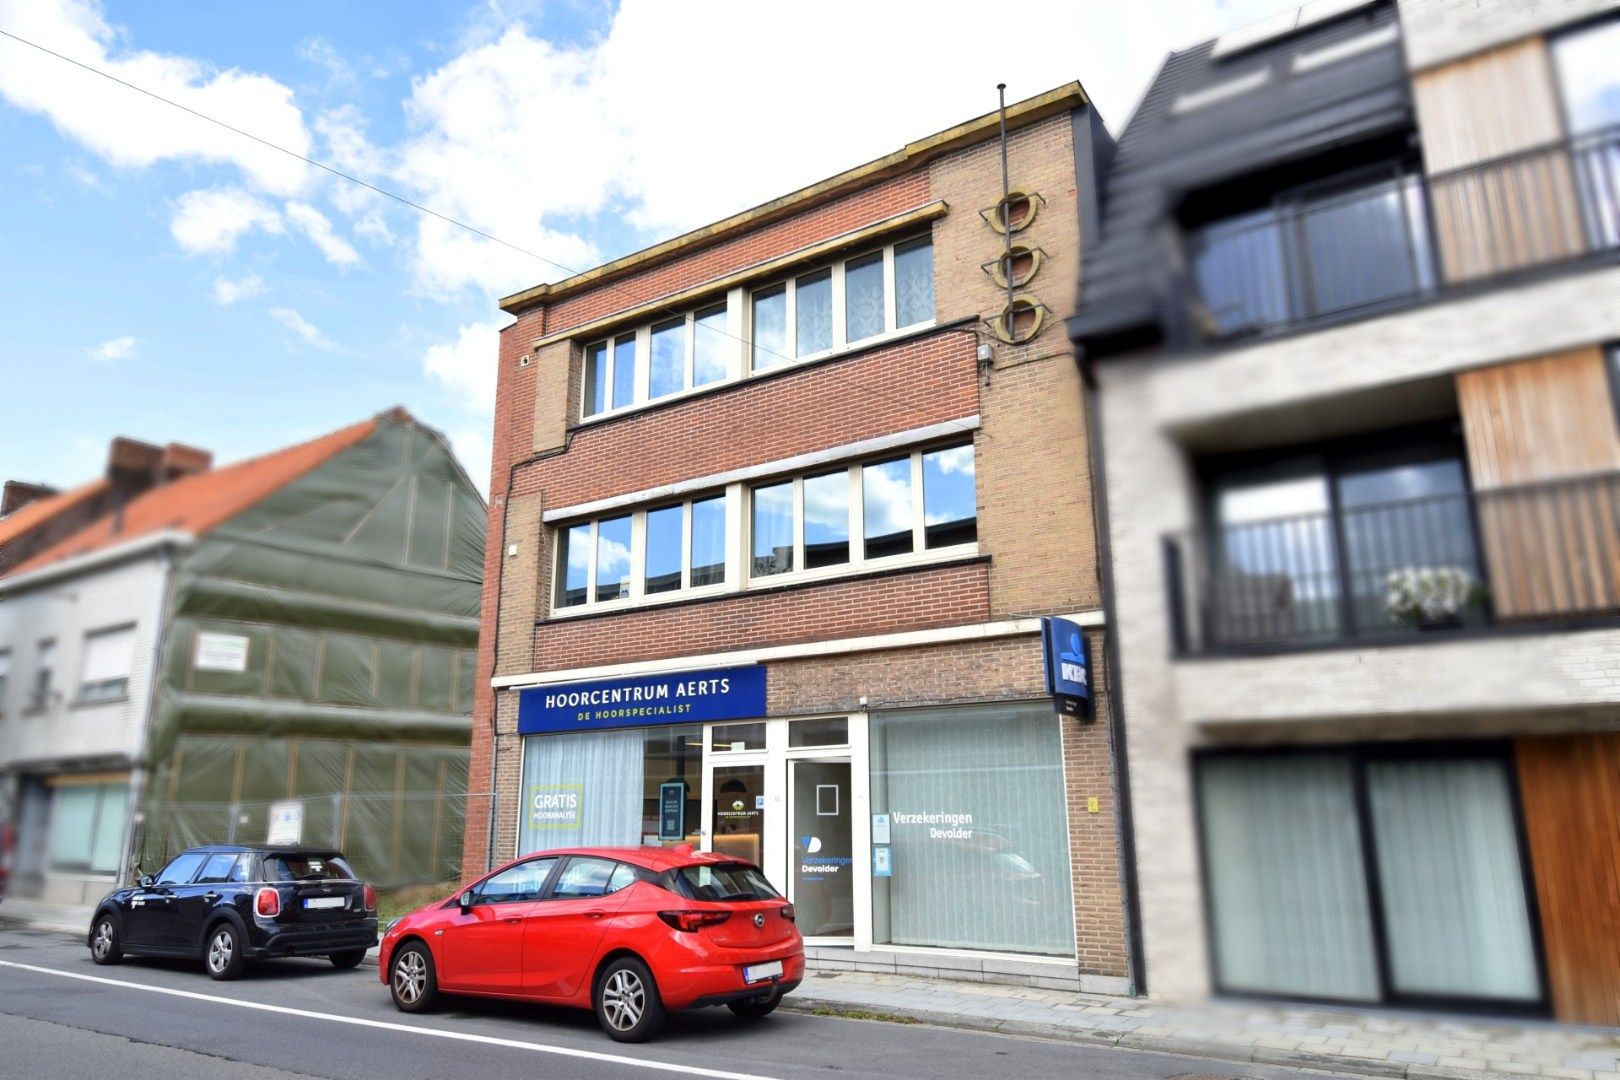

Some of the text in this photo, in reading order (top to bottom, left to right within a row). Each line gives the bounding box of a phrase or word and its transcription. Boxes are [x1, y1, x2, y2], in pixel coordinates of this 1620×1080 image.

[545, 678, 730, 709] HOORCENTRUM AERTS
[578, 703, 691, 721] DE HOORSPECIALIST
[534, 793, 578, 809] GRATIS
[533, 810, 577, 820] HOORANALYSE
[893, 811, 973, 827] Verzekeringen
[930, 827, 973, 839] Devolder
[802, 865, 839, 873] Devolder
